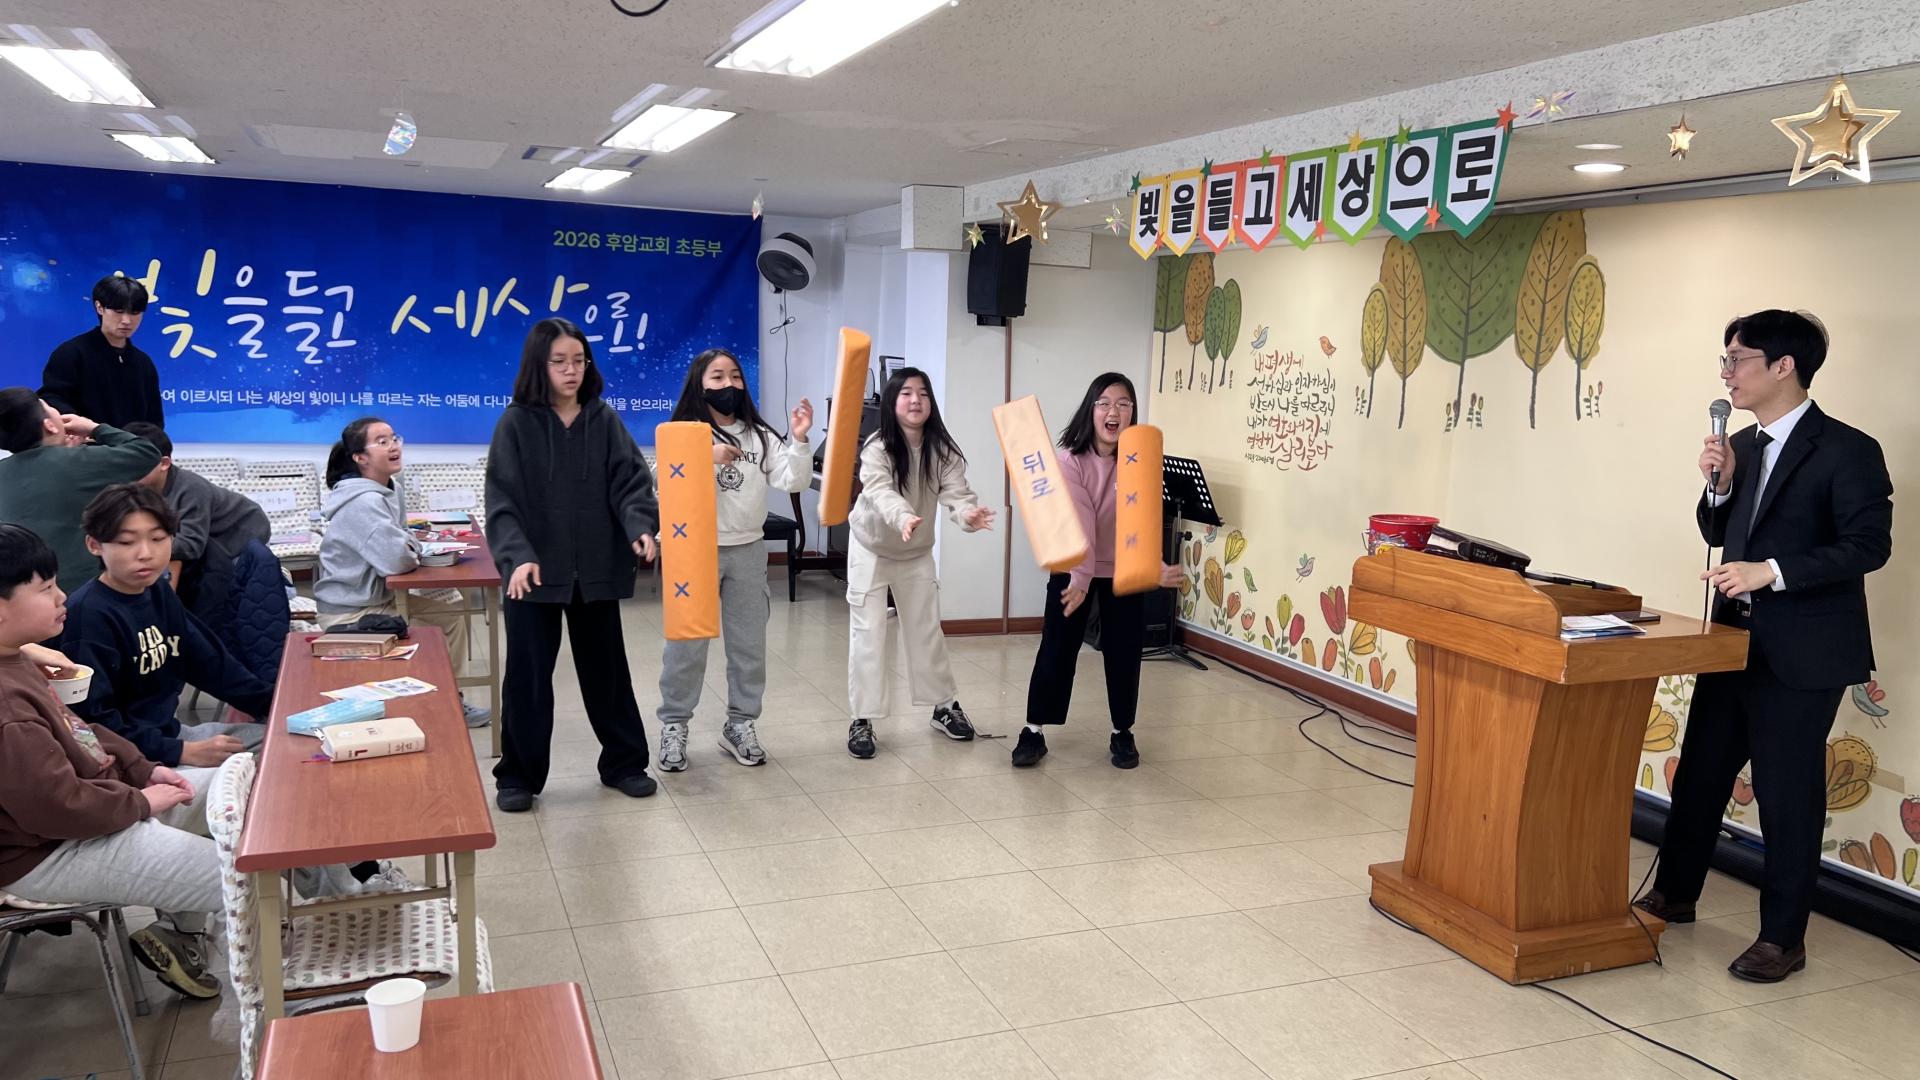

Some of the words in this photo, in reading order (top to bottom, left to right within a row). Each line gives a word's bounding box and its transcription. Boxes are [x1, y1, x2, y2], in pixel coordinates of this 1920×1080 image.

[553, 230, 601, 249] 2026
[605, 233, 670, 255] 후암교회
[675, 238, 723, 258] 초등부
[180, 389, 233, 405] 이르시되
[238, 390, 263, 405] 나는
[267, 390, 306, 406] 세상의
[310, 391, 346, 406] 빛이니
[350, 392, 374, 407] 나를
[378, 392, 414, 407] 따르는
[417, 393, 441, 408] 자는
[445, 394, 480, 408] 어둠에
[630, 397, 673, 412] 얻으리라
[1250, 392, 1276, 413] 반드시
[1277, 395, 1299, 417] 나를
[1247, 414, 1268, 429] 내가
